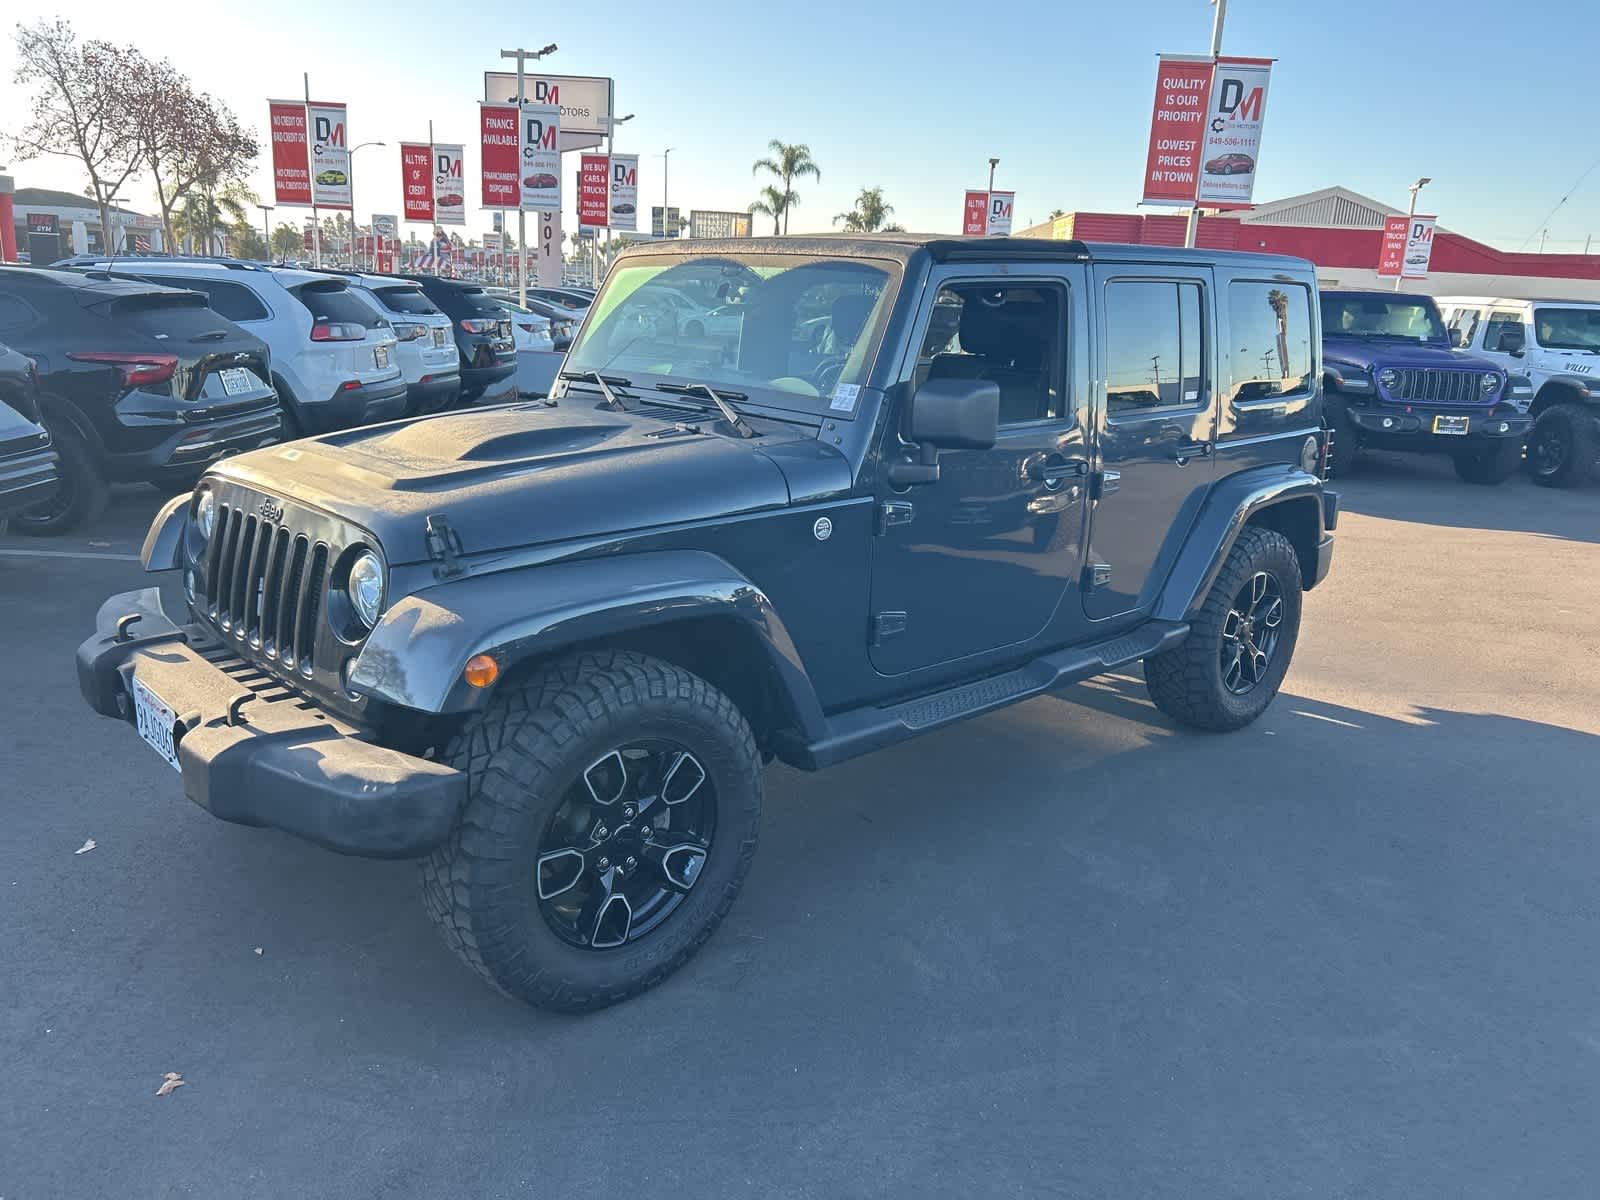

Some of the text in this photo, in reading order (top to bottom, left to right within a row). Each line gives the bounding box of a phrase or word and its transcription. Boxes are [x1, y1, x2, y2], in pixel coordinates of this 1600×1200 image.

[1163, 78, 1206, 90] QUALITY
[1165, 94, 1199, 106] IS OUR
[1219, 78, 1263, 121] DM
[560, 107, 590, 117] OTORS
[1157, 111, 1202, 122] PRIORITY
[486, 118, 514, 130] FINANCE
[316, 117, 344, 147] DM
[527, 119, 556, 150] DM
[483, 134, 518, 146] AVAILABLE
[1157, 139, 1196, 151] LOWEST
[405, 154, 428, 165] ALL TYPE
[1158, 156, 1191, 167] PRICES
[438, 155, 461, 177] DM
[583, 163, 606, 172] WE BUY
[412, 170, 421, 180] OF
[584, 174, 600, 183] CARS
[614, 164, 636, 186] DM
[1152, 171, 1193, 183] IN TOWN
[408, 184, 426, 195] CREDIT
[583, 185, 606, 194] TRUCKS
[406, 200, 431, 210] WELCOME
[1390, 223, 1405, 231] CARS
[1386, 232, 1407, 240] TRUCKS
